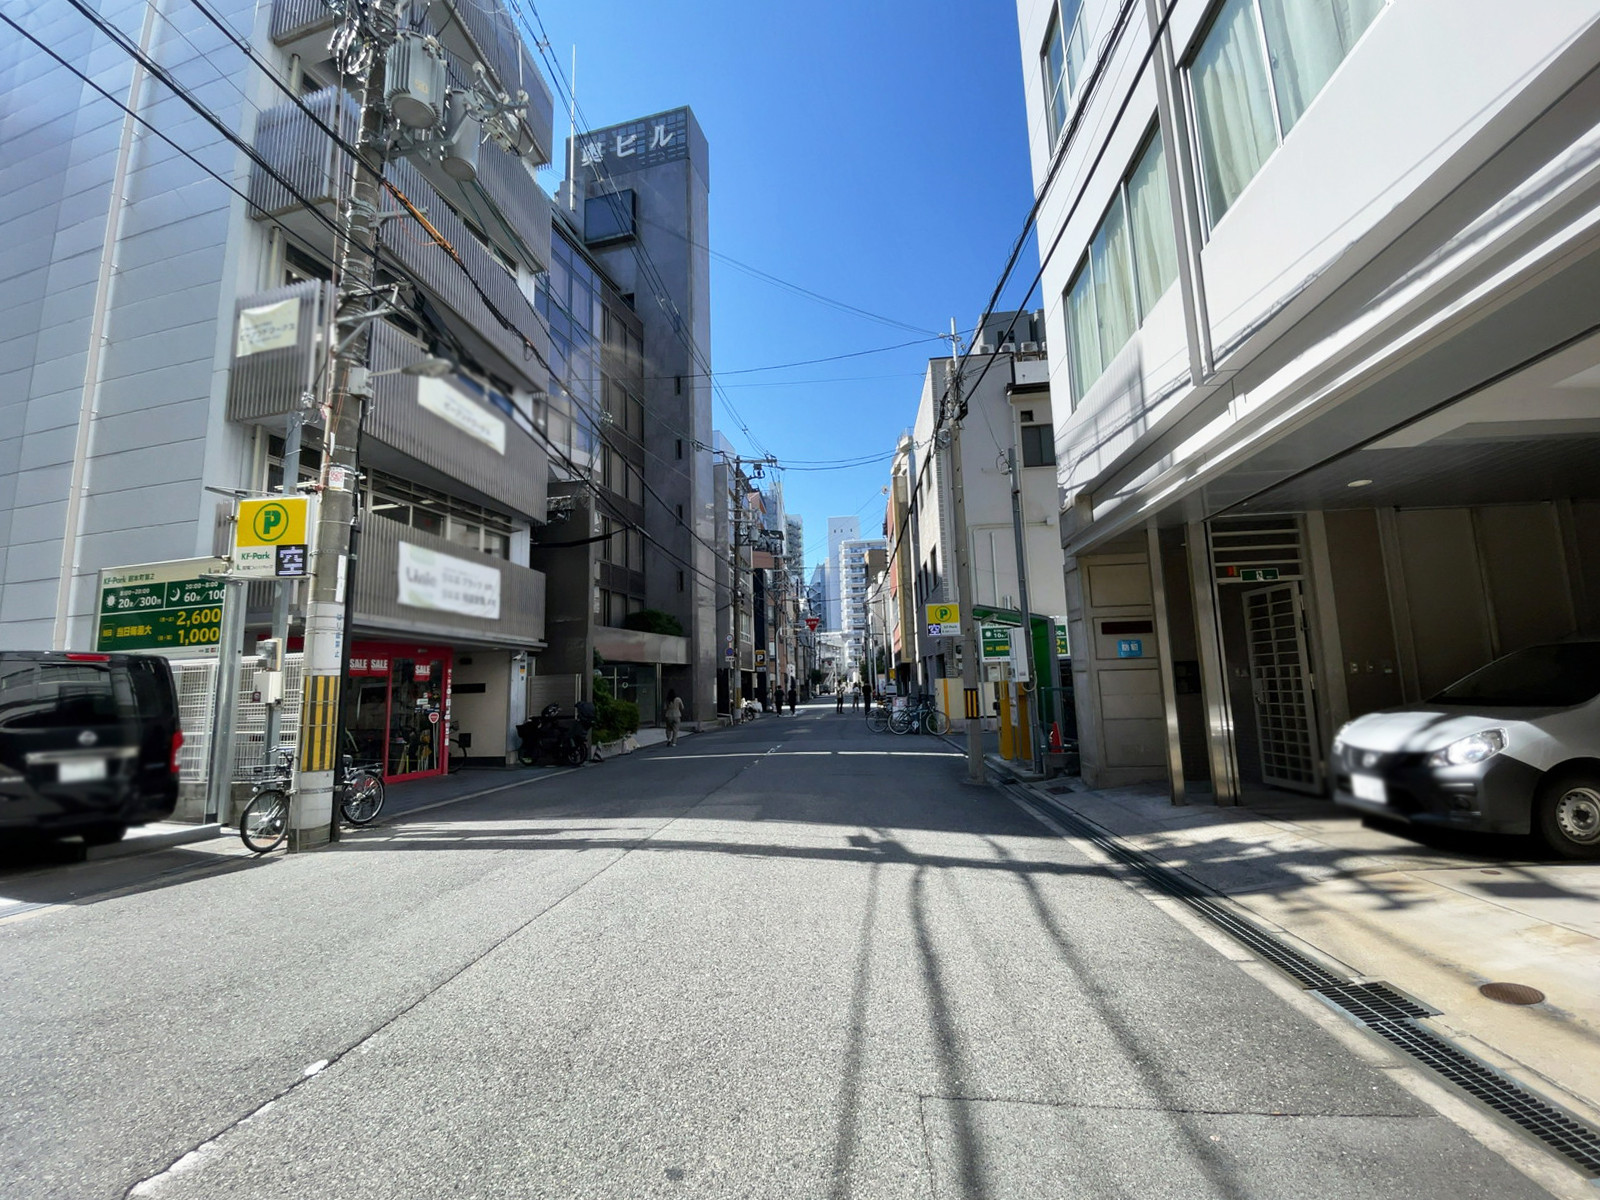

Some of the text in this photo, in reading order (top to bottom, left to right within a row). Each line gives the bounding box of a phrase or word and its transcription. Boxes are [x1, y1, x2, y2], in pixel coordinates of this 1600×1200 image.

[263, 510, 281, 534] P
[241, 551, 270, 560] KF-Park
[279, 546, 304, 575] 空
[176, 608, 221, 627] 2,600
[177, 627, 220, 646] 1,000
[349, 658, 368, 669] SALE
[371, 659, 388, 669] SALE
[415, 665, 431, 675] SALE
